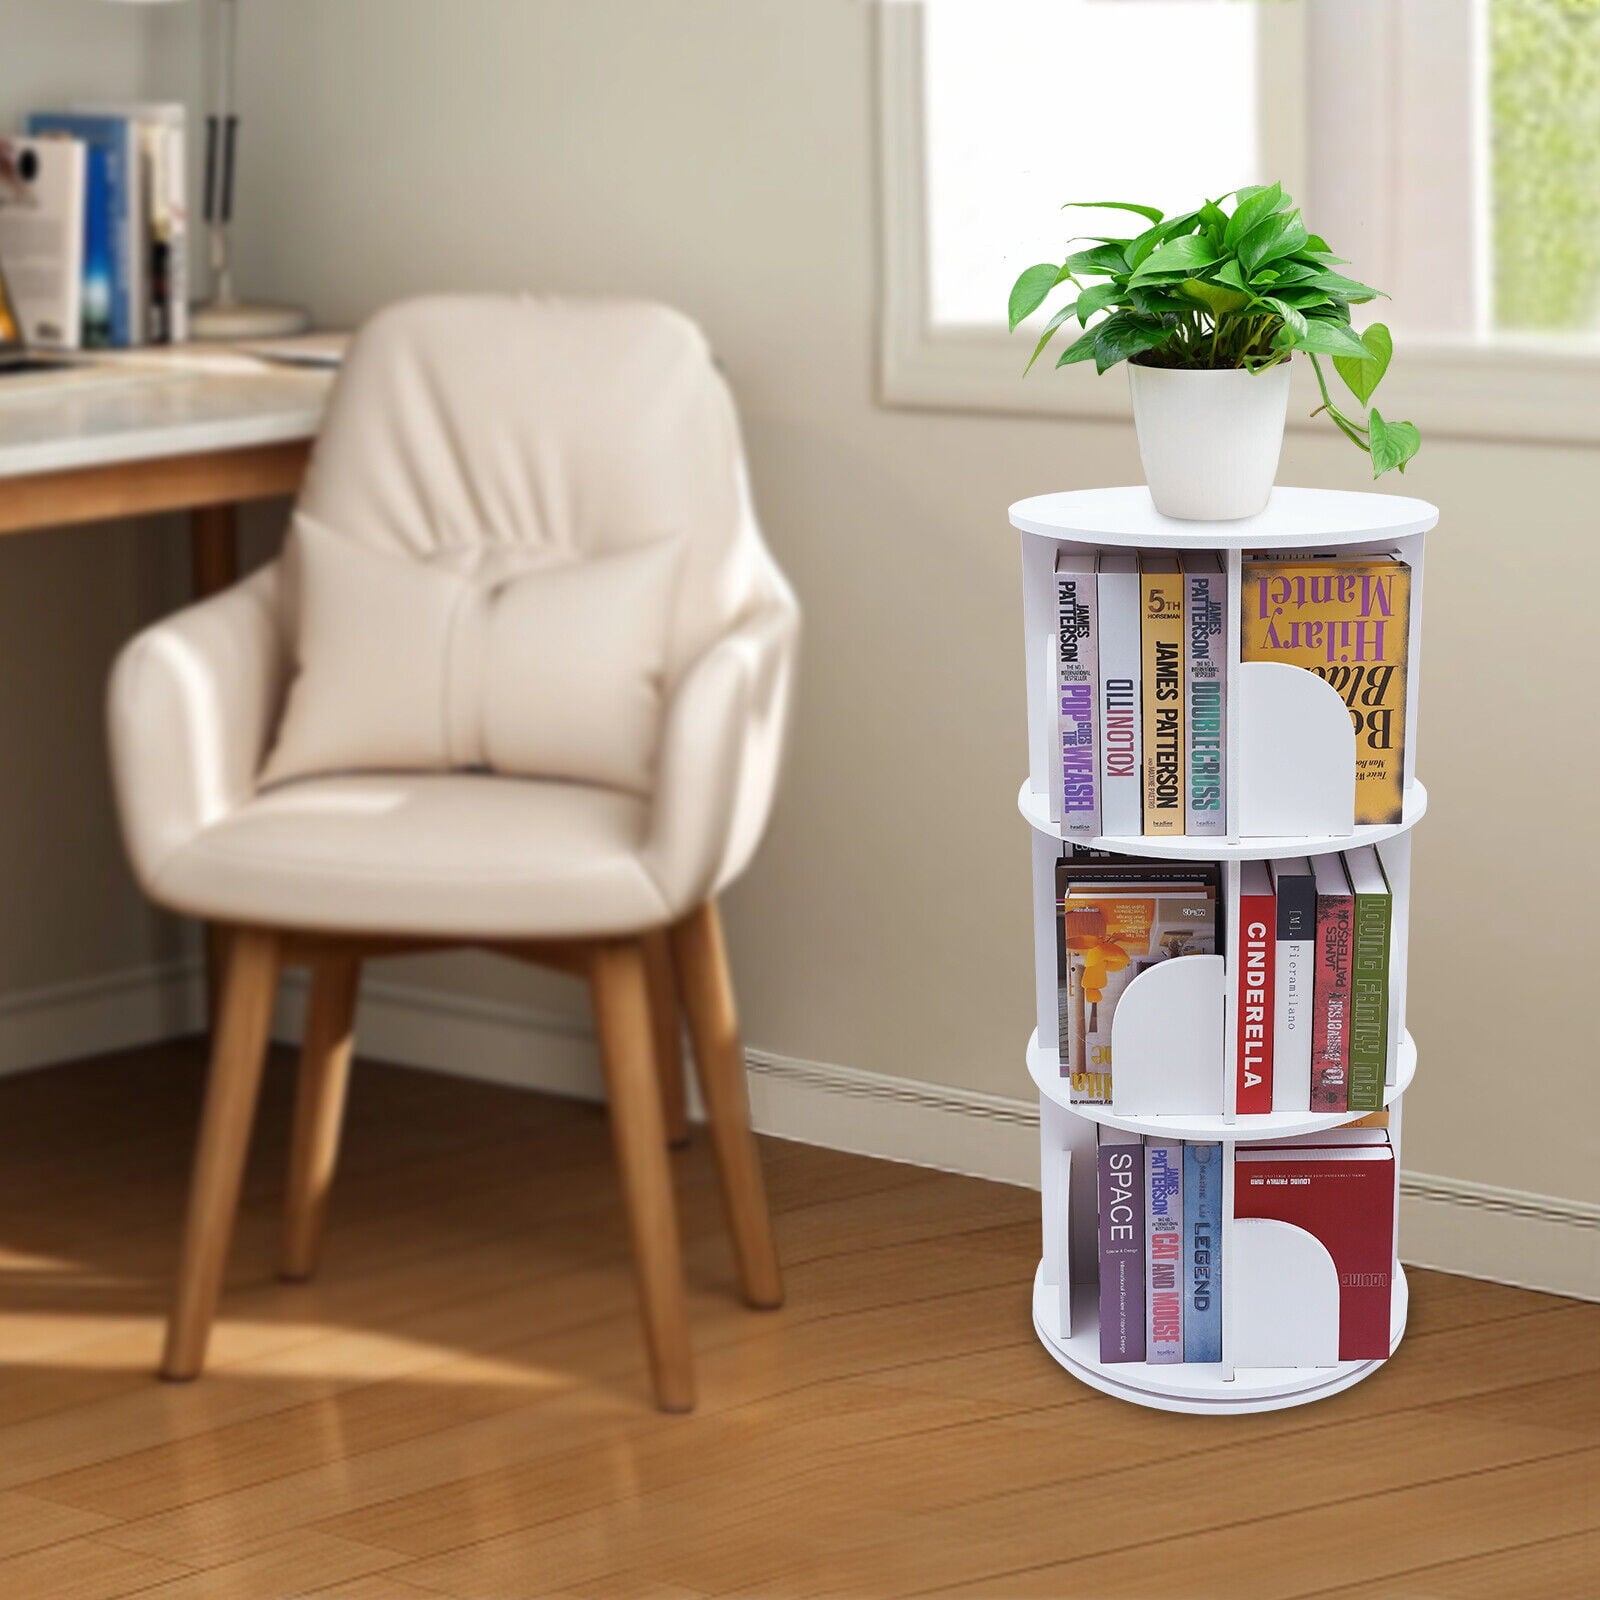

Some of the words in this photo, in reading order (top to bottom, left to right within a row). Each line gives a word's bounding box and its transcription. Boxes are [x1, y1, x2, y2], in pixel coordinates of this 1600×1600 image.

[1059, 581, 1078, 662] PATTERSON
[1077, 604, 1090, 638] JAMES
[1191, 578, 1210, 659] PATTERSON
[1208, 600, 1222, 636] JAMES
[1257, 574, 1397, 620] Mantel
[1259, 607, 1390, 663] Hilary
[1156, 641, 1179, 701] JAMES
[1303, 665, 1399, 707] Bla
[1061, 685, 1092, 721] POP
[1063, 745, 1095, 813] WEASEL
[1156, 708, 1179, 809] PATTERSON
[1366, 771, 1387, 780] Twice
[1325, 926, 1337, 971] JAMES
[1335, 910, 1350, 988] PATTERSON
[1244, 921, 1267, 1089] CINDERELLA
[1287, 945, 1300, 1030] Fieramilano
[1354, 979, 1383, 1053] FAMILY
[1352, 1062, 1380, 1107] MAN
[1109, 1153, 1133, 1241] SPACE
[1151, 1149, 1168, 1216] PATTERSON
[1167, 1167, 1179, 1195] JAMES
[1151, 1232, 1179, 1261] CAT
[1193, 1222, 1211, 1312] LEGEND
[1151, 1263, 1175, 1289] AND
[1151, 1292, 1180, 1343] MOUSE
